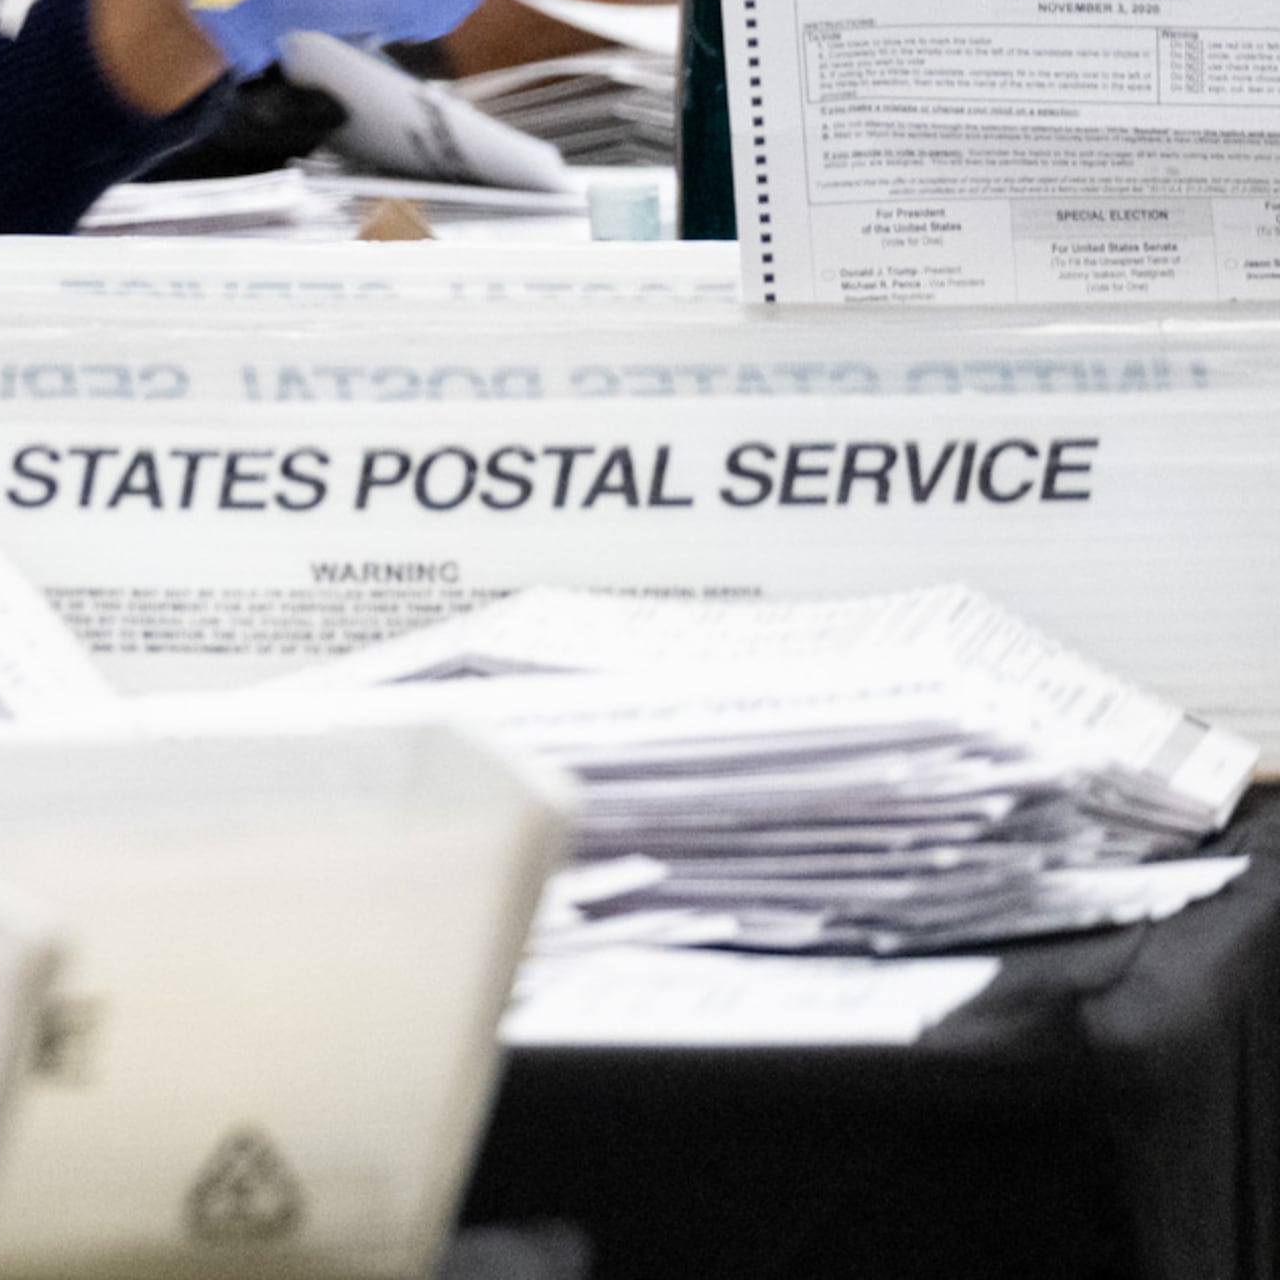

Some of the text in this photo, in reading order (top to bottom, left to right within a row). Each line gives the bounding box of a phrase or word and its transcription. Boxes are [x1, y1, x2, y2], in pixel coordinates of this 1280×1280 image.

[1038, 2, 1113, 15] NOVEMBER
[876, 206, 946, 219] For President
[1056, 209, 1169, 222] SPECIAL ELECTION
[861, 220, 962, 235] of the United States
[1051, 241, 1179, 254] For United States Senate
[840, 266, 874, 277] Donald
[887, 264, 918, 277] Trump
[841, 279, 878, 291] Michael
[891, 277, 922, 289] Pence
[5, 442, 330, 512] STATES
[352, 442, 695, 512] POSTAL
[718, 437, 1100, 510] SERVICE
[310, 561, 461, 584] WARNING
